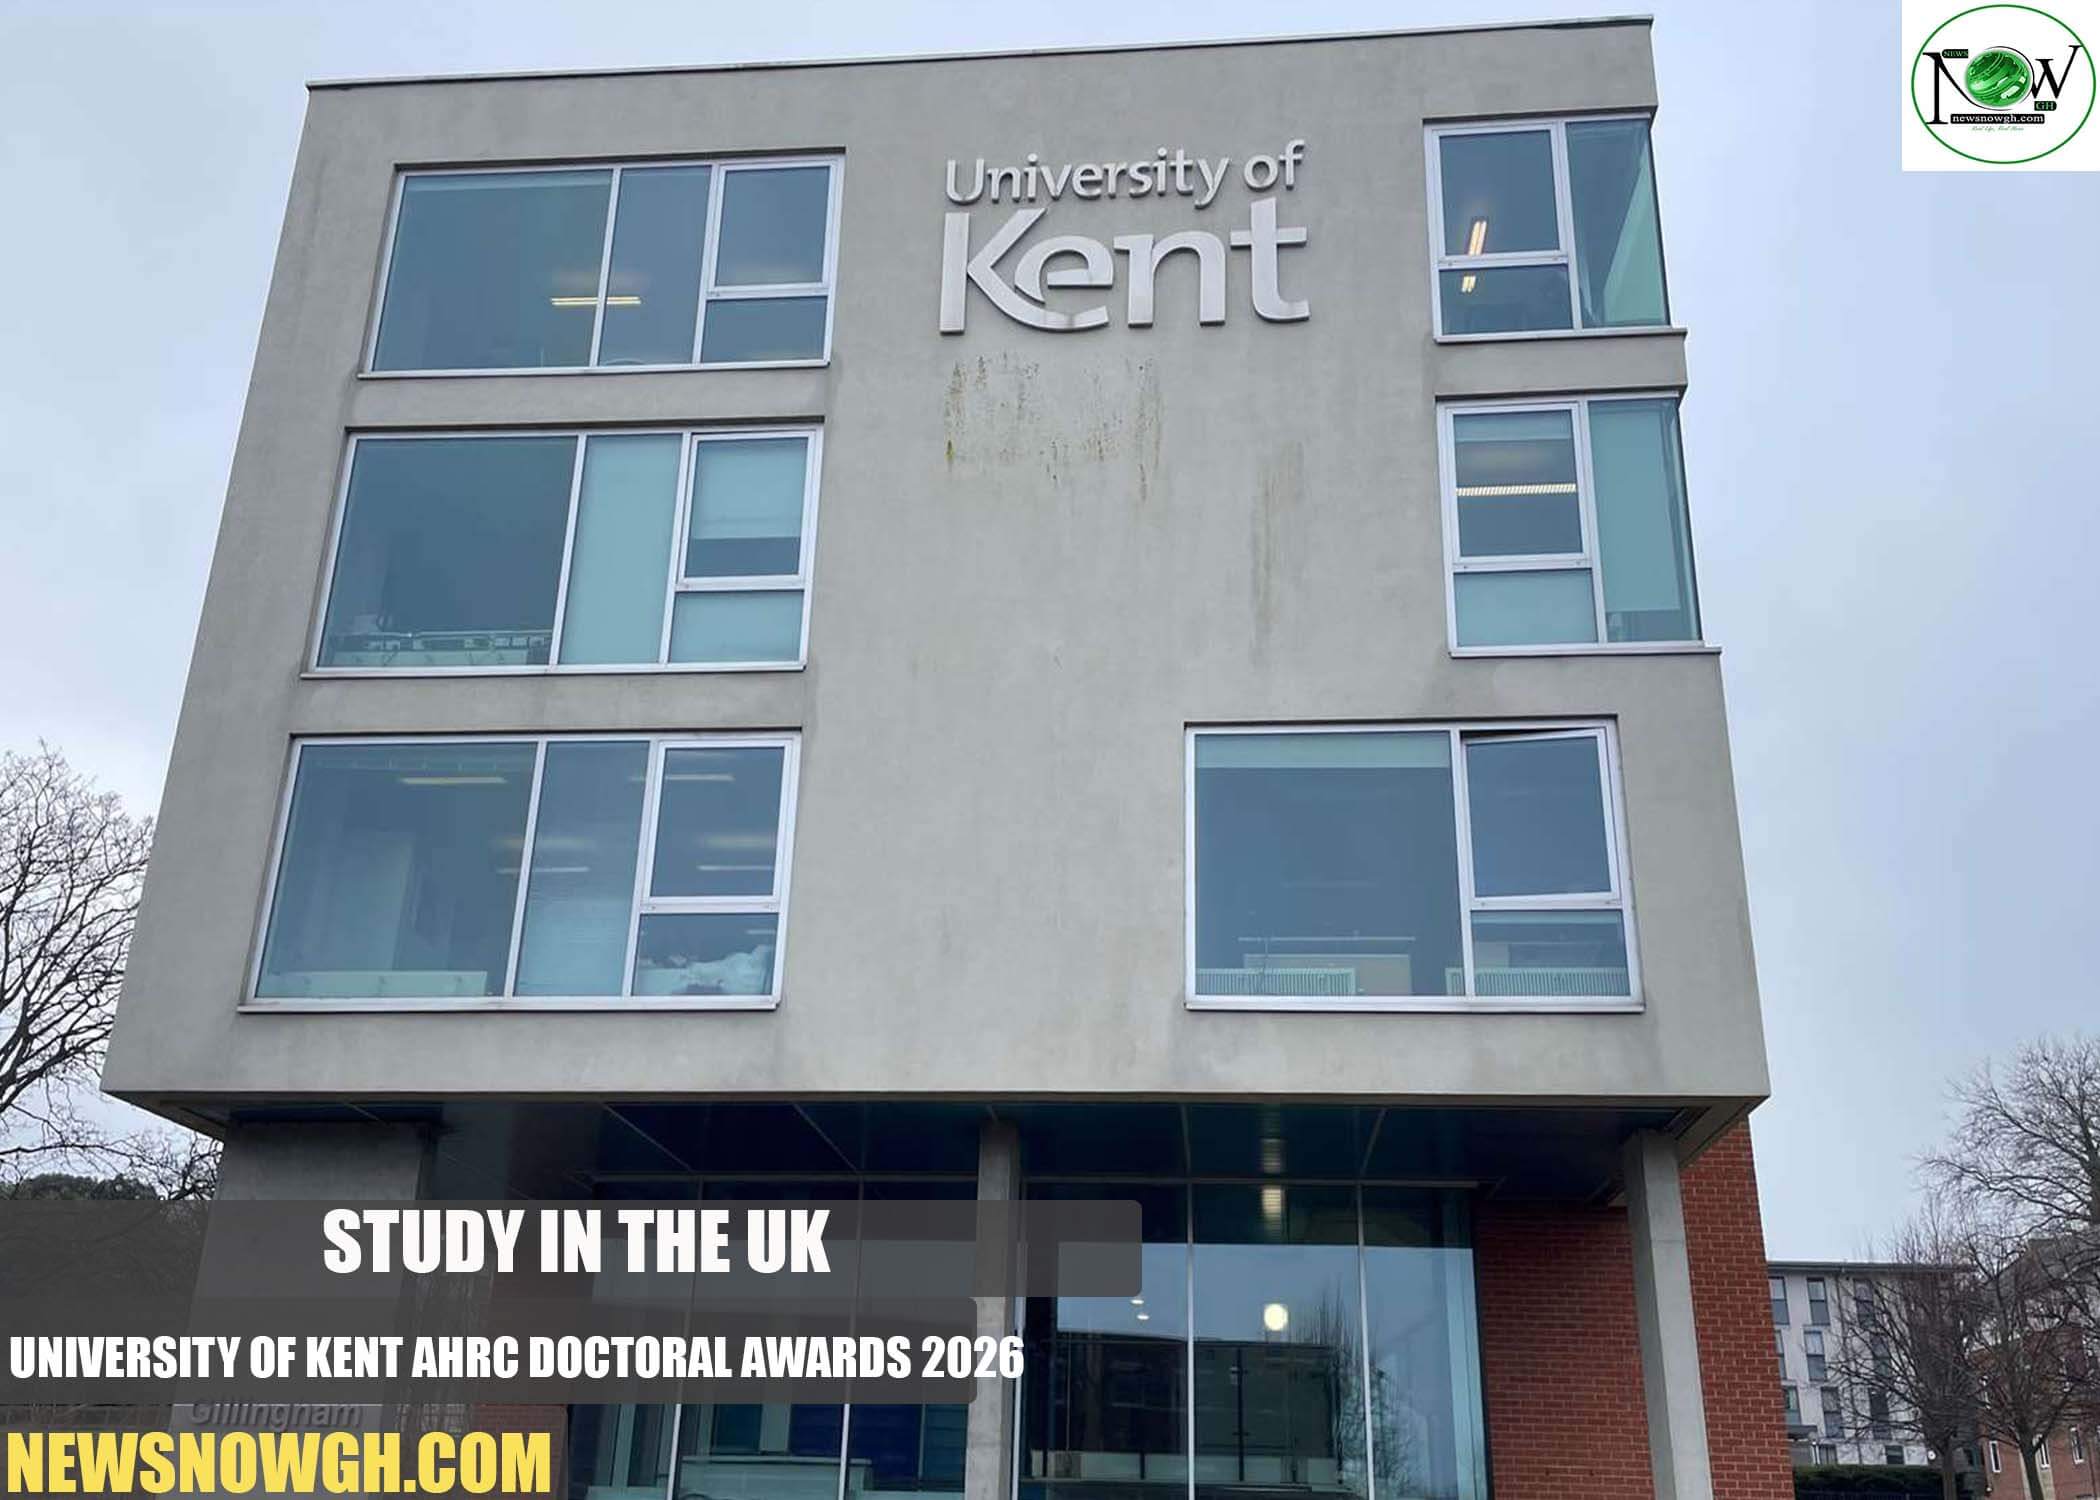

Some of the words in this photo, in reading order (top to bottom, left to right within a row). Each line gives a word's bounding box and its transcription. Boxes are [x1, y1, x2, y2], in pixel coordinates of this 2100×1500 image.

[945, 147, 1230, 209] University
[1243, 139, 1305, 192] of
[939, 197, 1311, 335] Kent
